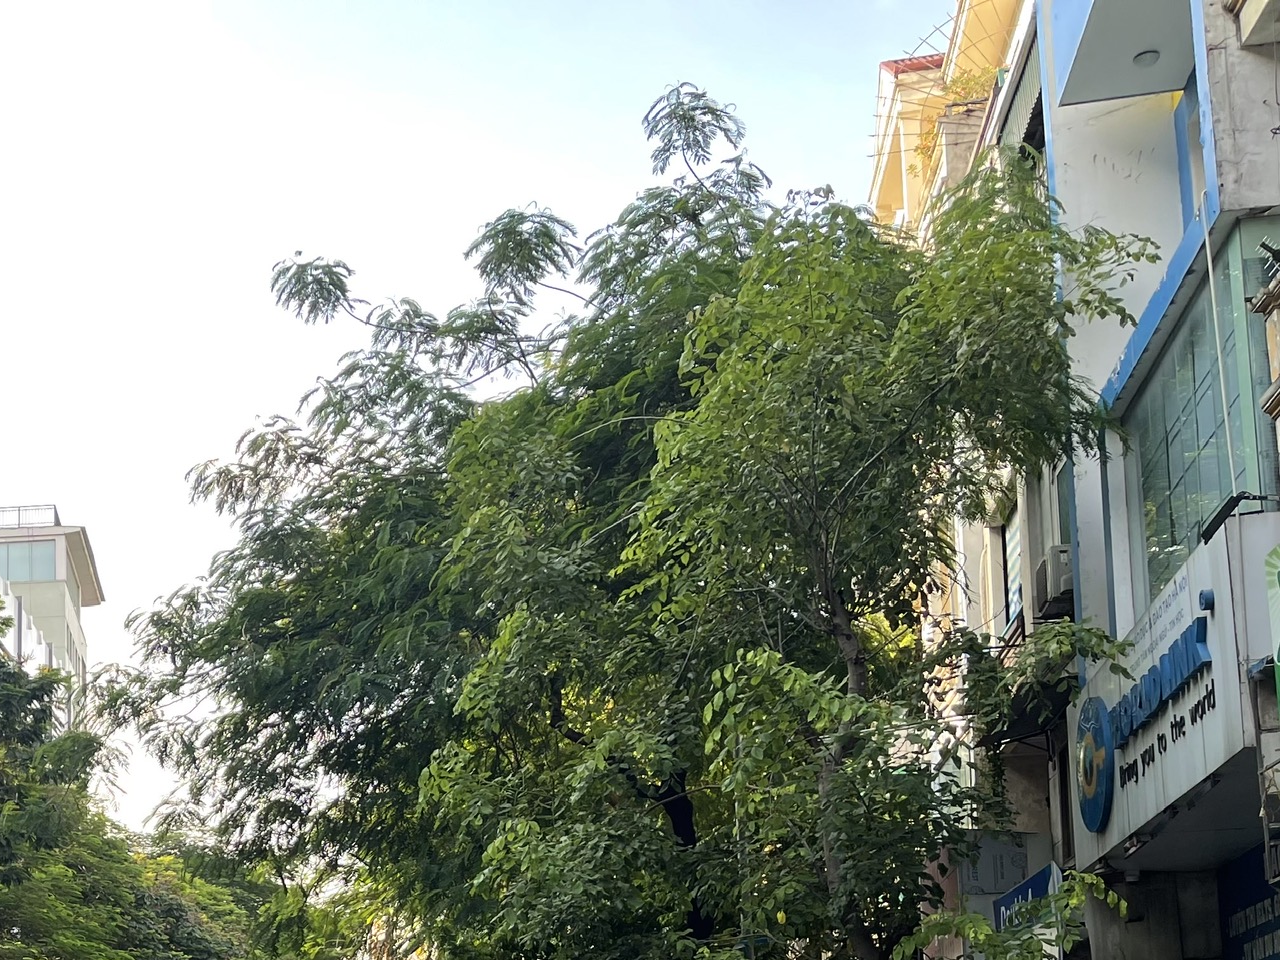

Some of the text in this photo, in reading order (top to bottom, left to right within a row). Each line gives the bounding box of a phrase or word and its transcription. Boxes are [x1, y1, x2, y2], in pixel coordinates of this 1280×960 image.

[1157, 732, 1167, 756] to
[1170, 712, 1186, 744] the
[1188, 678, 1216, 727] world
